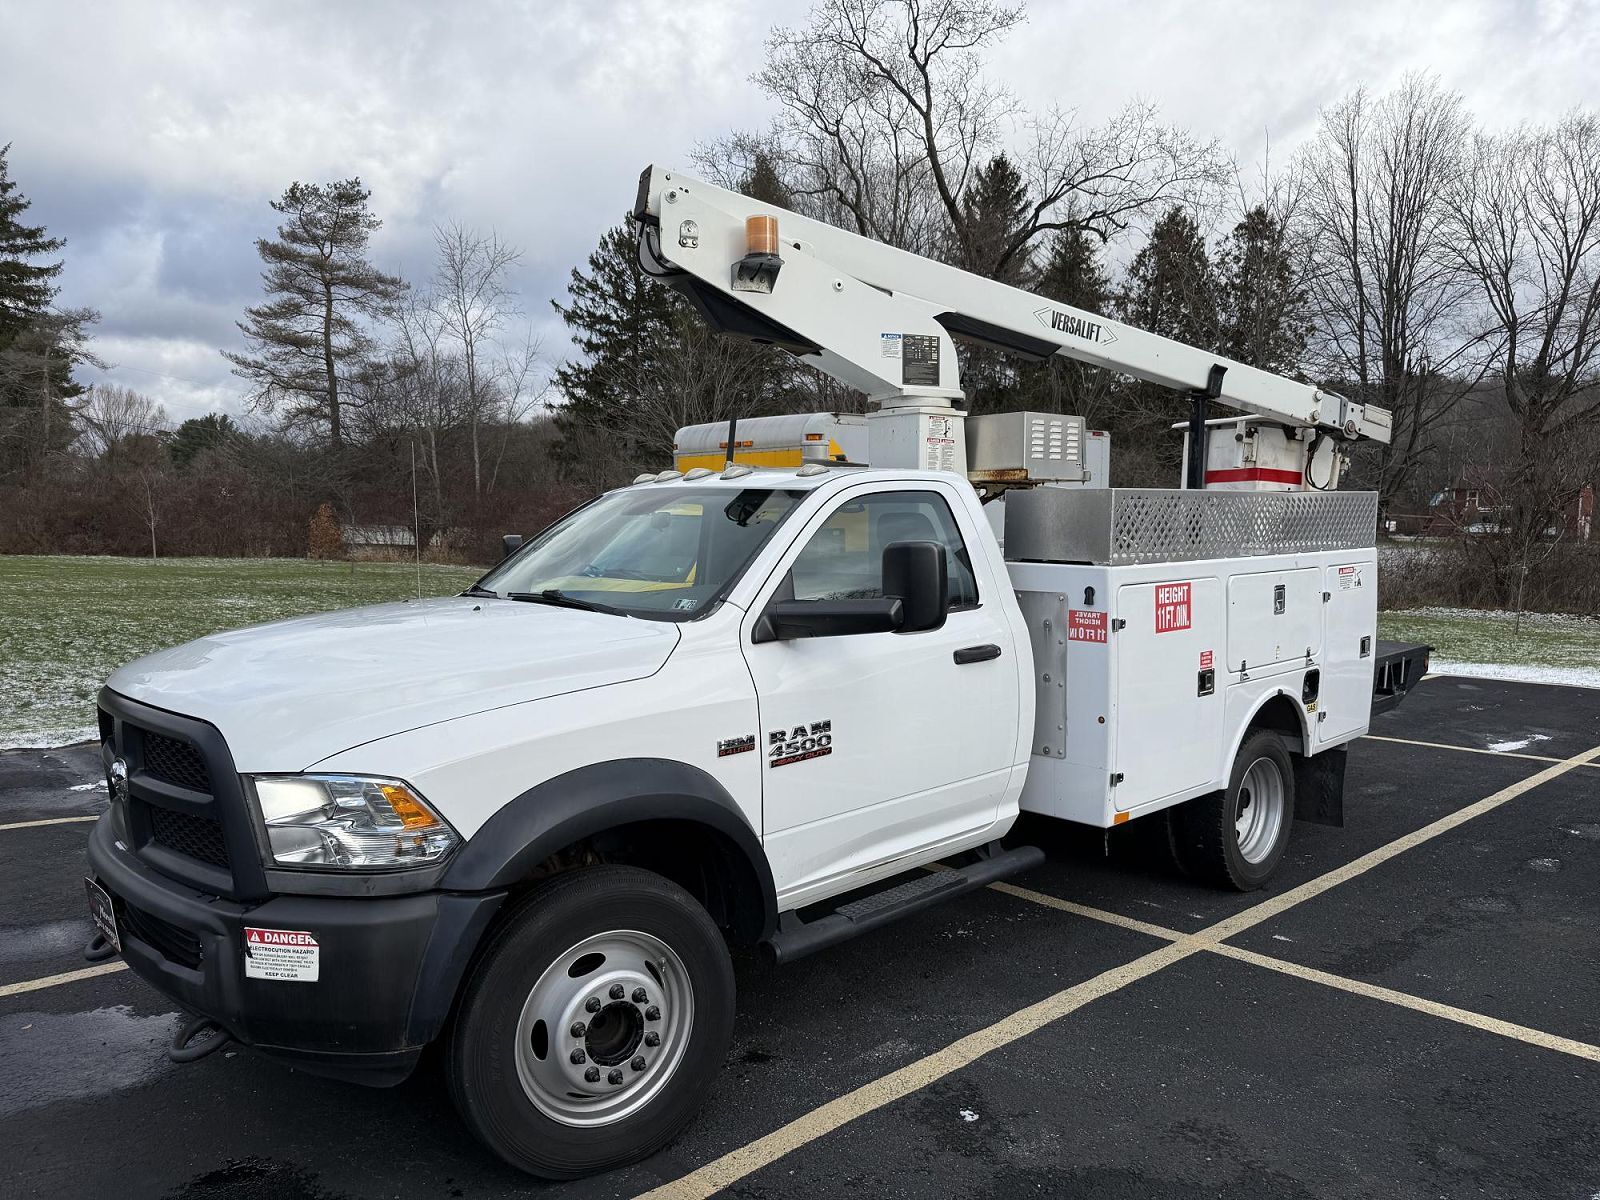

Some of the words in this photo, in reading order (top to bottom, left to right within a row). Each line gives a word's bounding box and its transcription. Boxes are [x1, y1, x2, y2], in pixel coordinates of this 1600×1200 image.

[1051, 310, 1101, 342] VERSALIFT
[1158, 586, 1188, 604] HEIGHT
[769, 720, 831, 744] RAM
[769, 734, 831, 757] 4500
[773, 755, 803, 767] HEAVY
[805, 748, 830, 759] DUTY
[264, 932, 313, 945] DANGER
